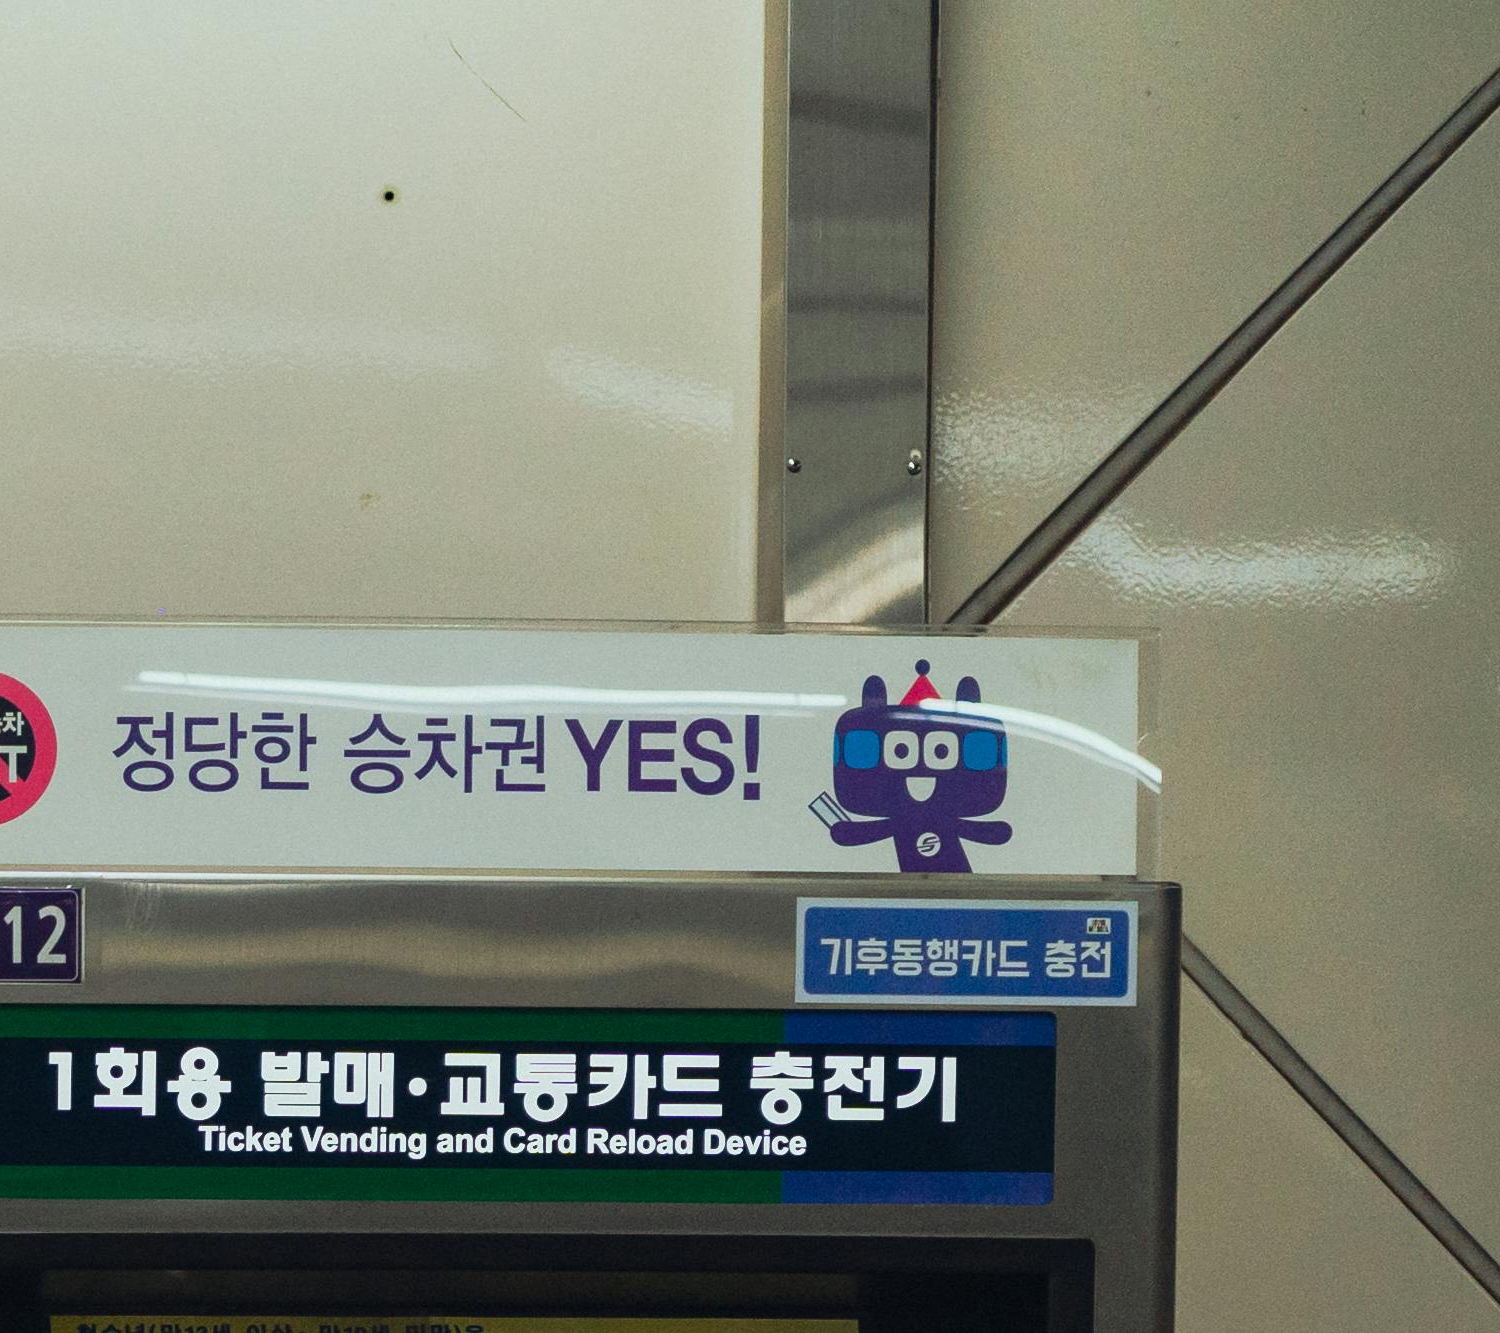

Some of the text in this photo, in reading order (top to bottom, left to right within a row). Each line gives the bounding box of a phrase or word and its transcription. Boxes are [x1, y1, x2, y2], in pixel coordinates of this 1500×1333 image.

[112, 711, 761, 802] 정당한 승차권 YES!
[820, 937, 1112, 979] 기후동행카드 충전
[48, 1046, 232, 1122] 1회용
[749, 1050, 958, 1127] 충전기
[197, 1121, 808, 1161] Ticket Vending and Card Reload Device
